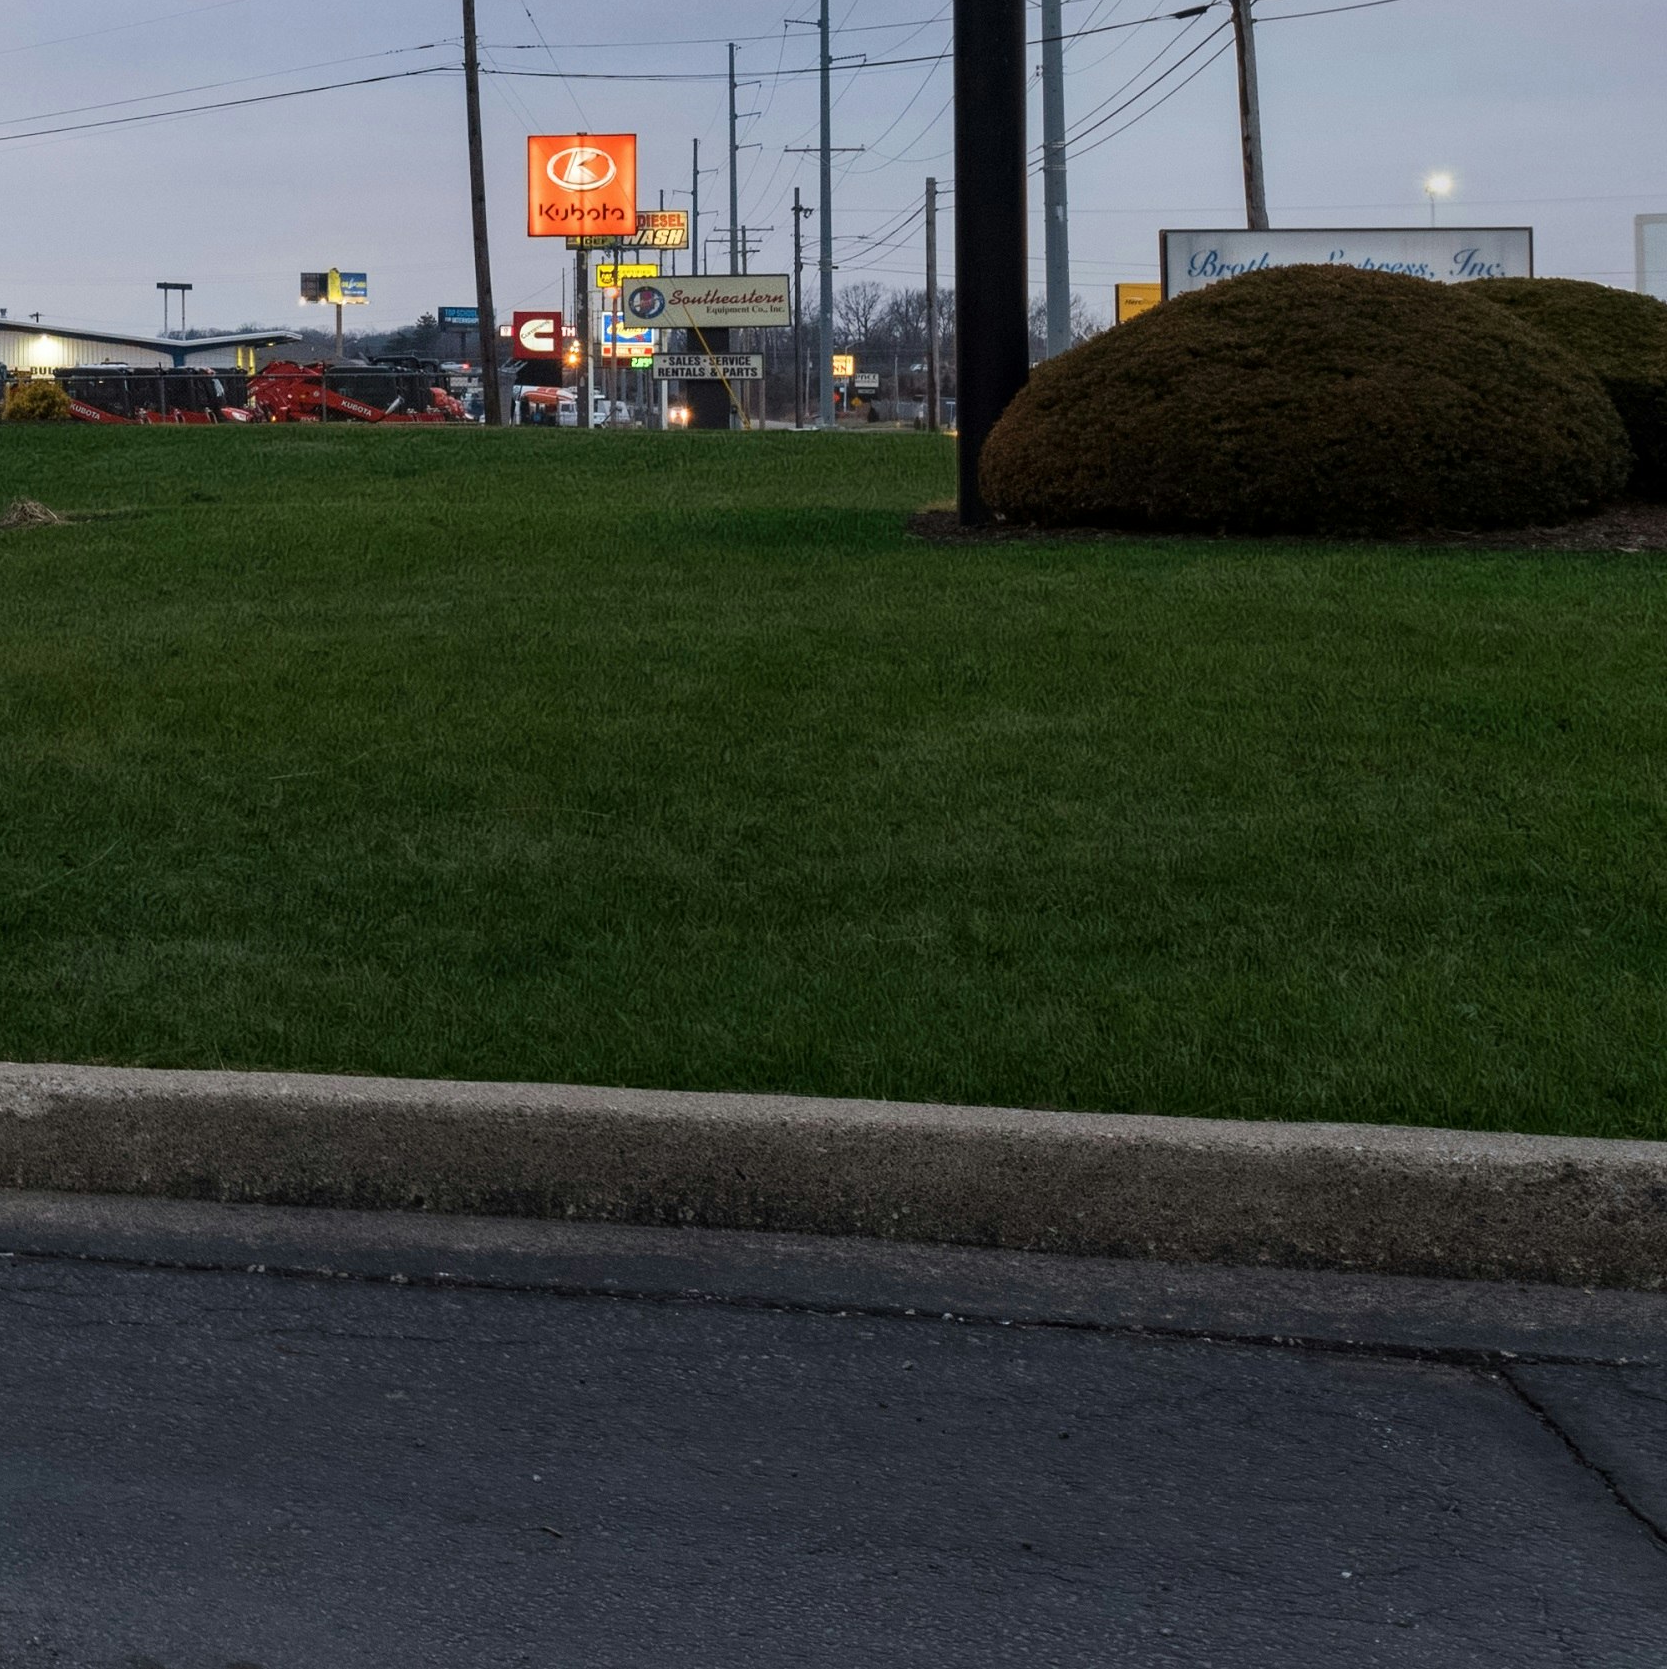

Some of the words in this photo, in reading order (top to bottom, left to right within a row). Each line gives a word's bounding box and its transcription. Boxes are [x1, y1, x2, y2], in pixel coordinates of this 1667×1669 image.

[539, 203, 625, 221] Kubota
[637, 213, 685, 228] DIESEL
[622, 228, 685, 246] WASH
[1450, 248, 1506, 277] Inc.
[668, 288, 785, 306] Southeastern
[706, 305, 750, 315] Equipment
[770, 304, 786, 313] Inc.
[669, 356, 701, 366] SALES
[709, 356, 751, 366] SERVICE
[658, 367, 705, 377] RENTALS
[710, 367, 718, 377] &
[723, 367, 758, 377] PARTS
[70, 402, 101, 420] KUBOTA
[341, 399, 372, 416] KUBOTA
